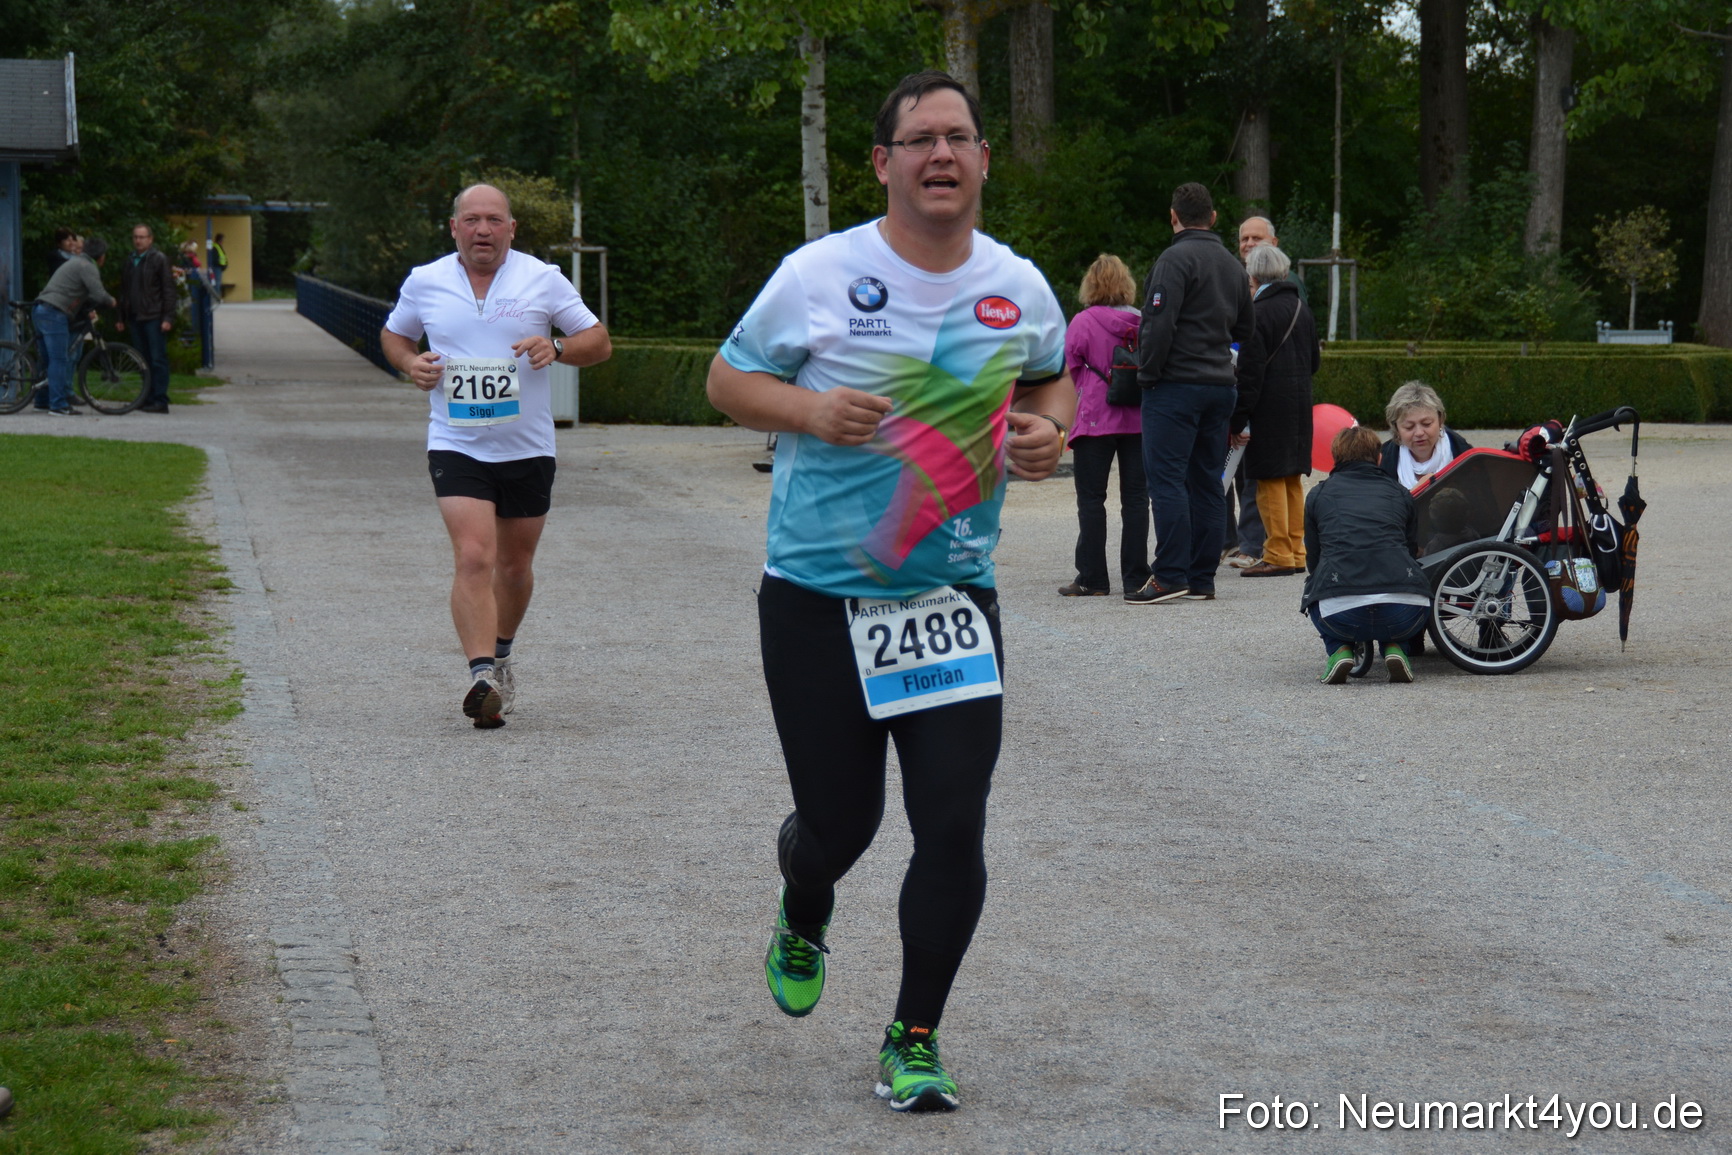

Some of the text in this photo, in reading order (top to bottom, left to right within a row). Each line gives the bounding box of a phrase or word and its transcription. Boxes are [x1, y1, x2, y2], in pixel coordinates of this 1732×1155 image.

[981, 303, 1017, 321] Hervis
[849, 318, 891, 329] PARTL
[849, 329, 892, 337] Neumarkt
[446, 364, 506, 372] PARTL Neumarkt
[452, 375, 512, 400] 2162
[469, 406, 495, 418] Siggi
[953, 517, 972, 537] 16.
[853, 592, 961, 619] PARTL Neumarkt
[867, 607, 979, 669] 2488
[902, 668, 965, 693] Florian
